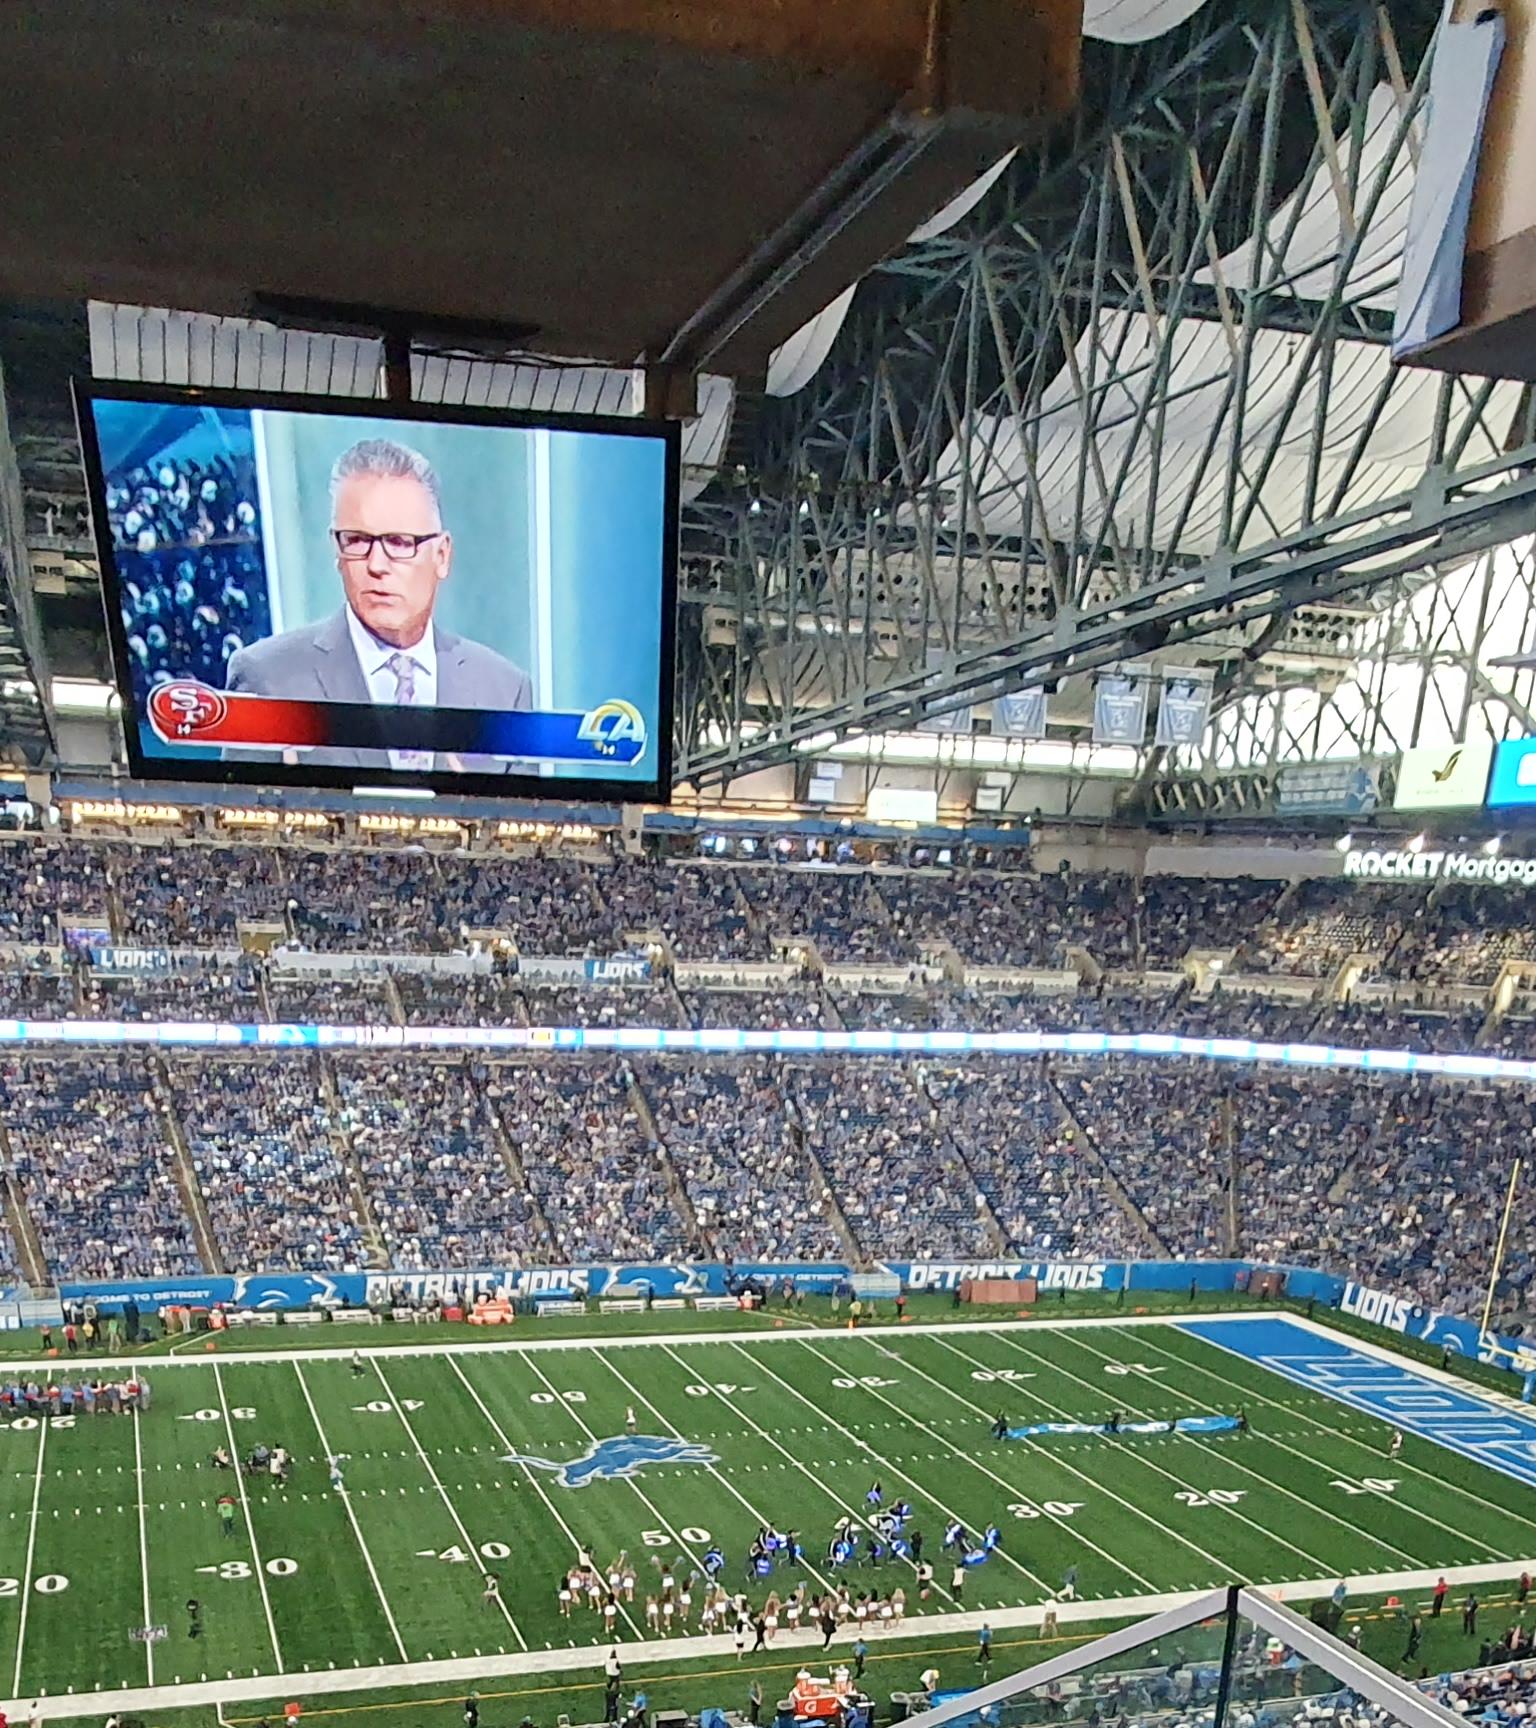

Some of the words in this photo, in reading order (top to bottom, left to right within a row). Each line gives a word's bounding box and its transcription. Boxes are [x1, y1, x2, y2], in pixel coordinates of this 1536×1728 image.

[1343, 851, 1445, 877] ROCKET
[1028, 1263, 1107, 1290] LIONS
[1340, 1281, 1415, 1333] LIONS
[1006, 1501, 1076, 1520] 30
[641, 1526, 712, 1547] 50
[438, 1541, 513, 1564] 40
[218, 1556, 300, 1580] 30
